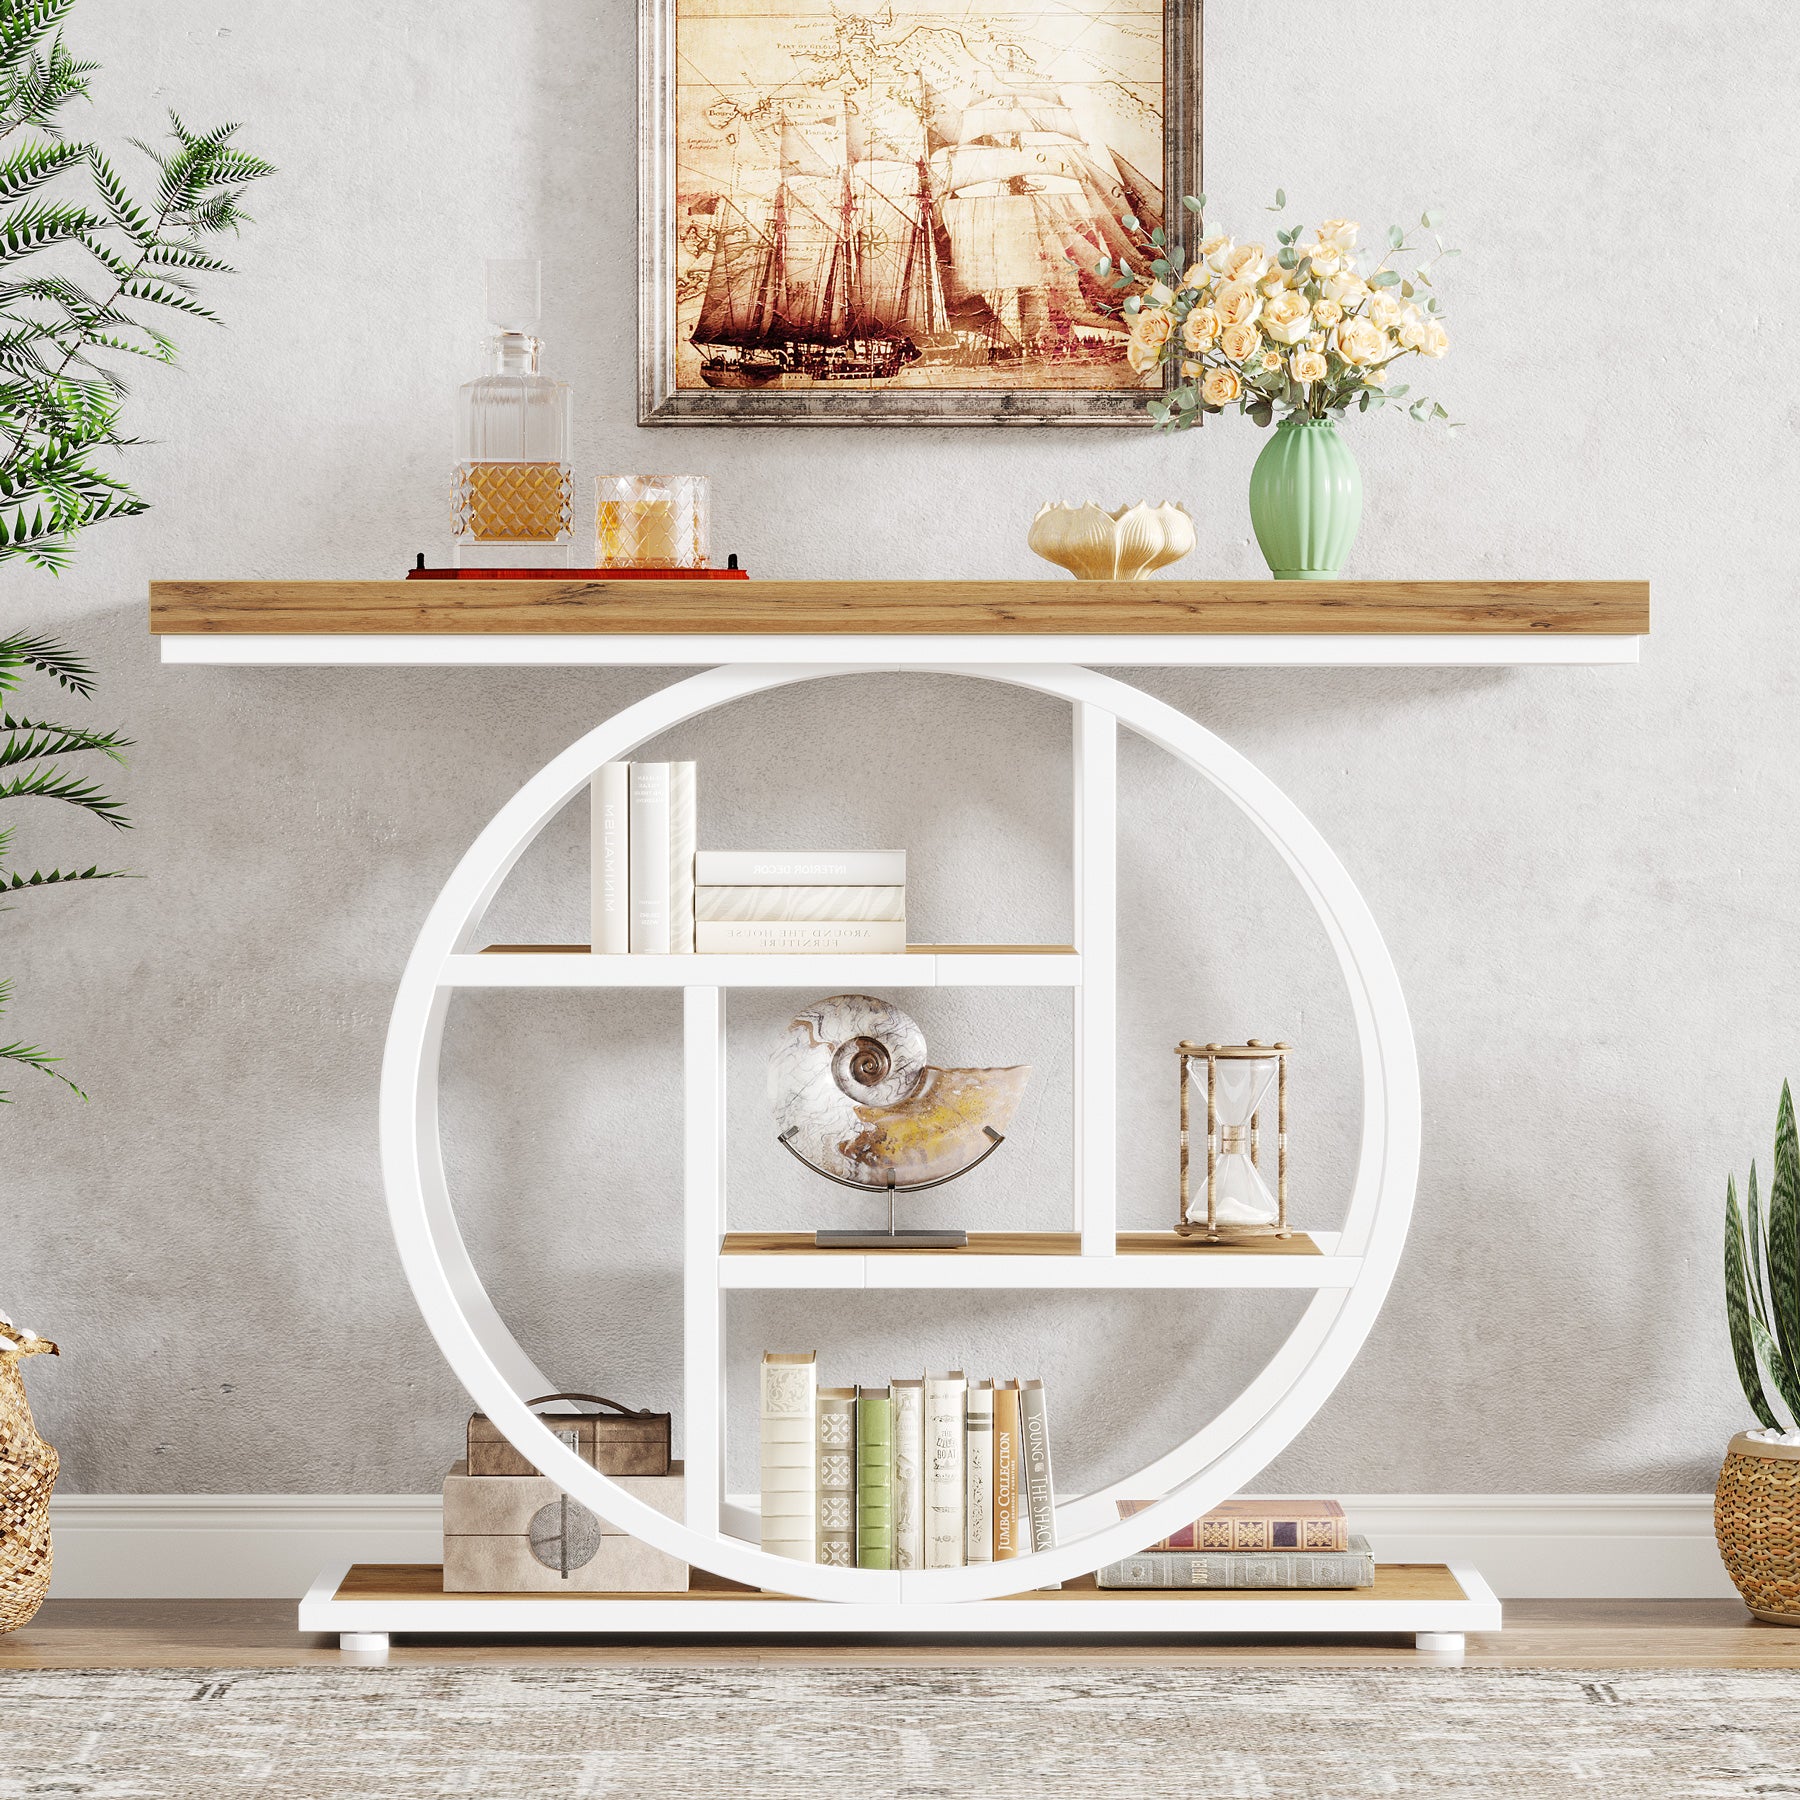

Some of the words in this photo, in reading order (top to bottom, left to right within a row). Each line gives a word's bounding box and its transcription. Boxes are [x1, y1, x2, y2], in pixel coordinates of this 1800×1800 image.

[1028, 1412, 1044, 1461] YOUNG
[997, 1431, 1011, 1507] COLLECTION
[1032, 1475, 1048, 1504] THE
[997, 1510, 1013, 1552] JUMBO
[1034, 1507, 1053, 1552] SHACK
